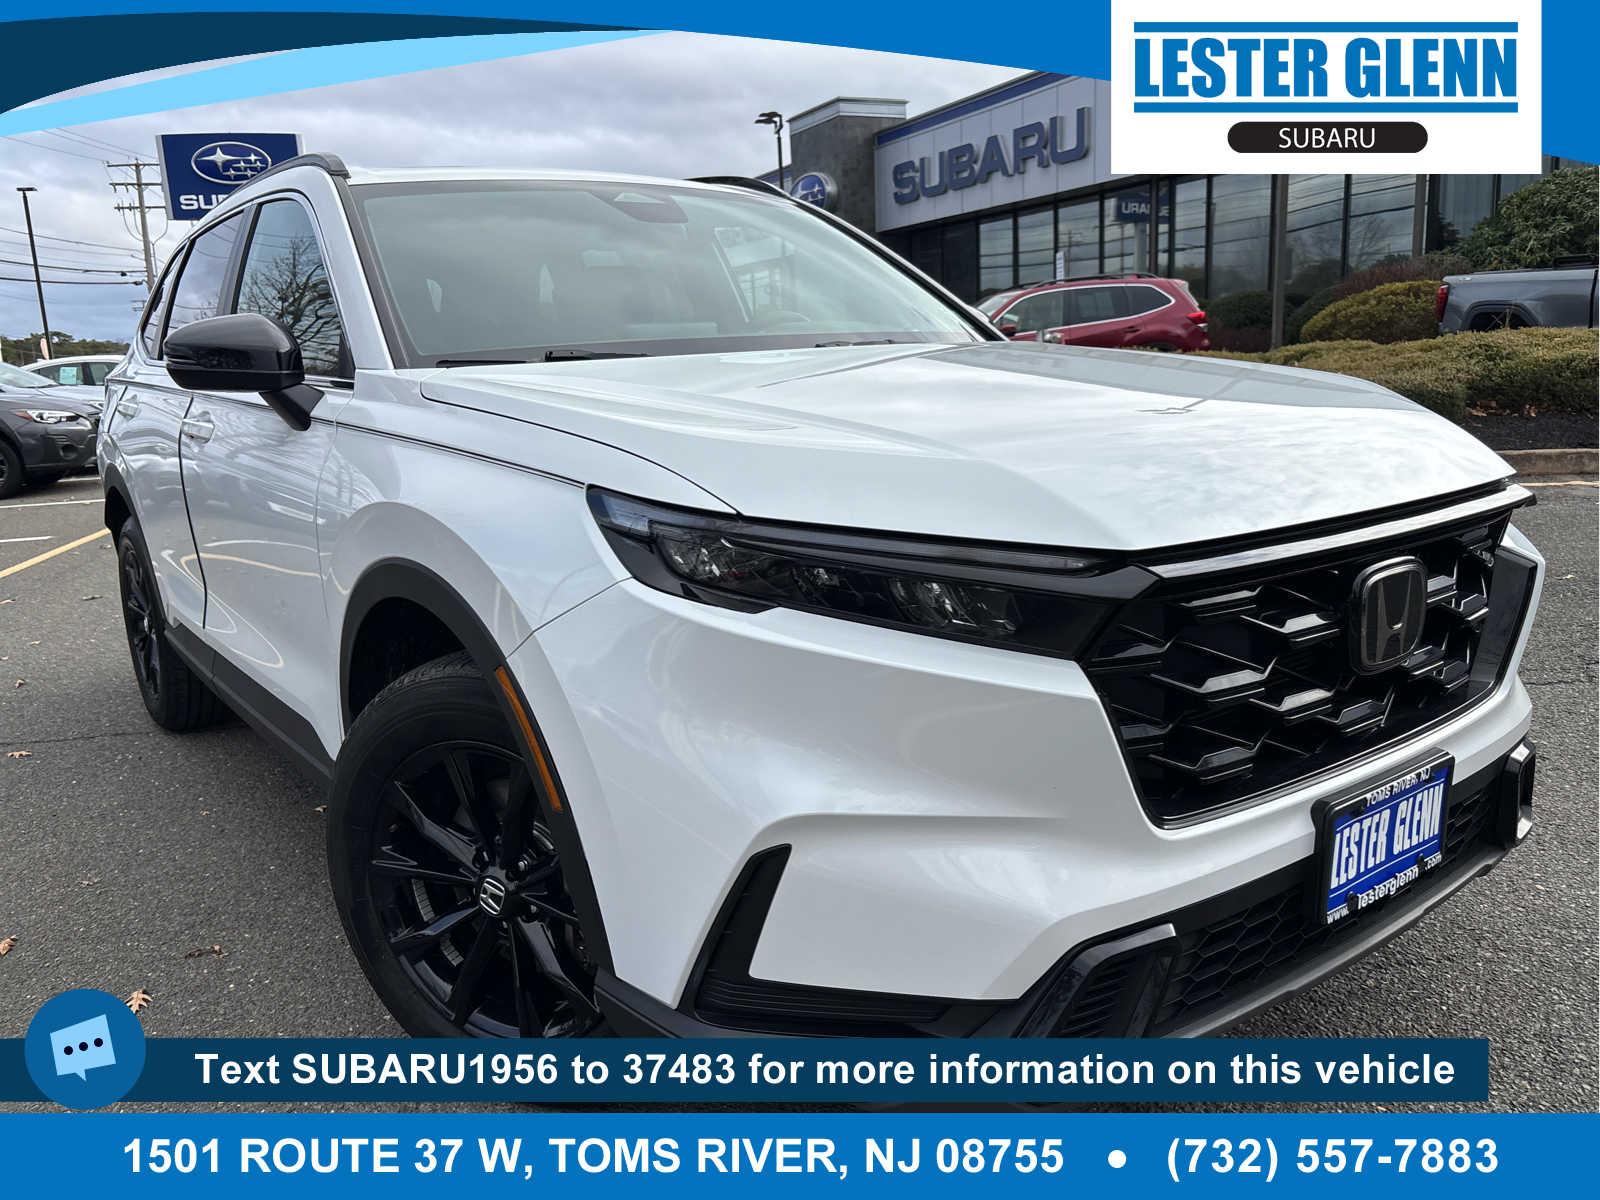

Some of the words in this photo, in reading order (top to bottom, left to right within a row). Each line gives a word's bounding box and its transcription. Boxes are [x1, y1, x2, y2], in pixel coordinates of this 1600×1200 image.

[892, 106, 1091, 205] SUBARU
[1330, 808, 1391, 889] LESTER
[1393, 783, 1444, 855] GLENN
[1366, 786, 1391, 806] TOMS
